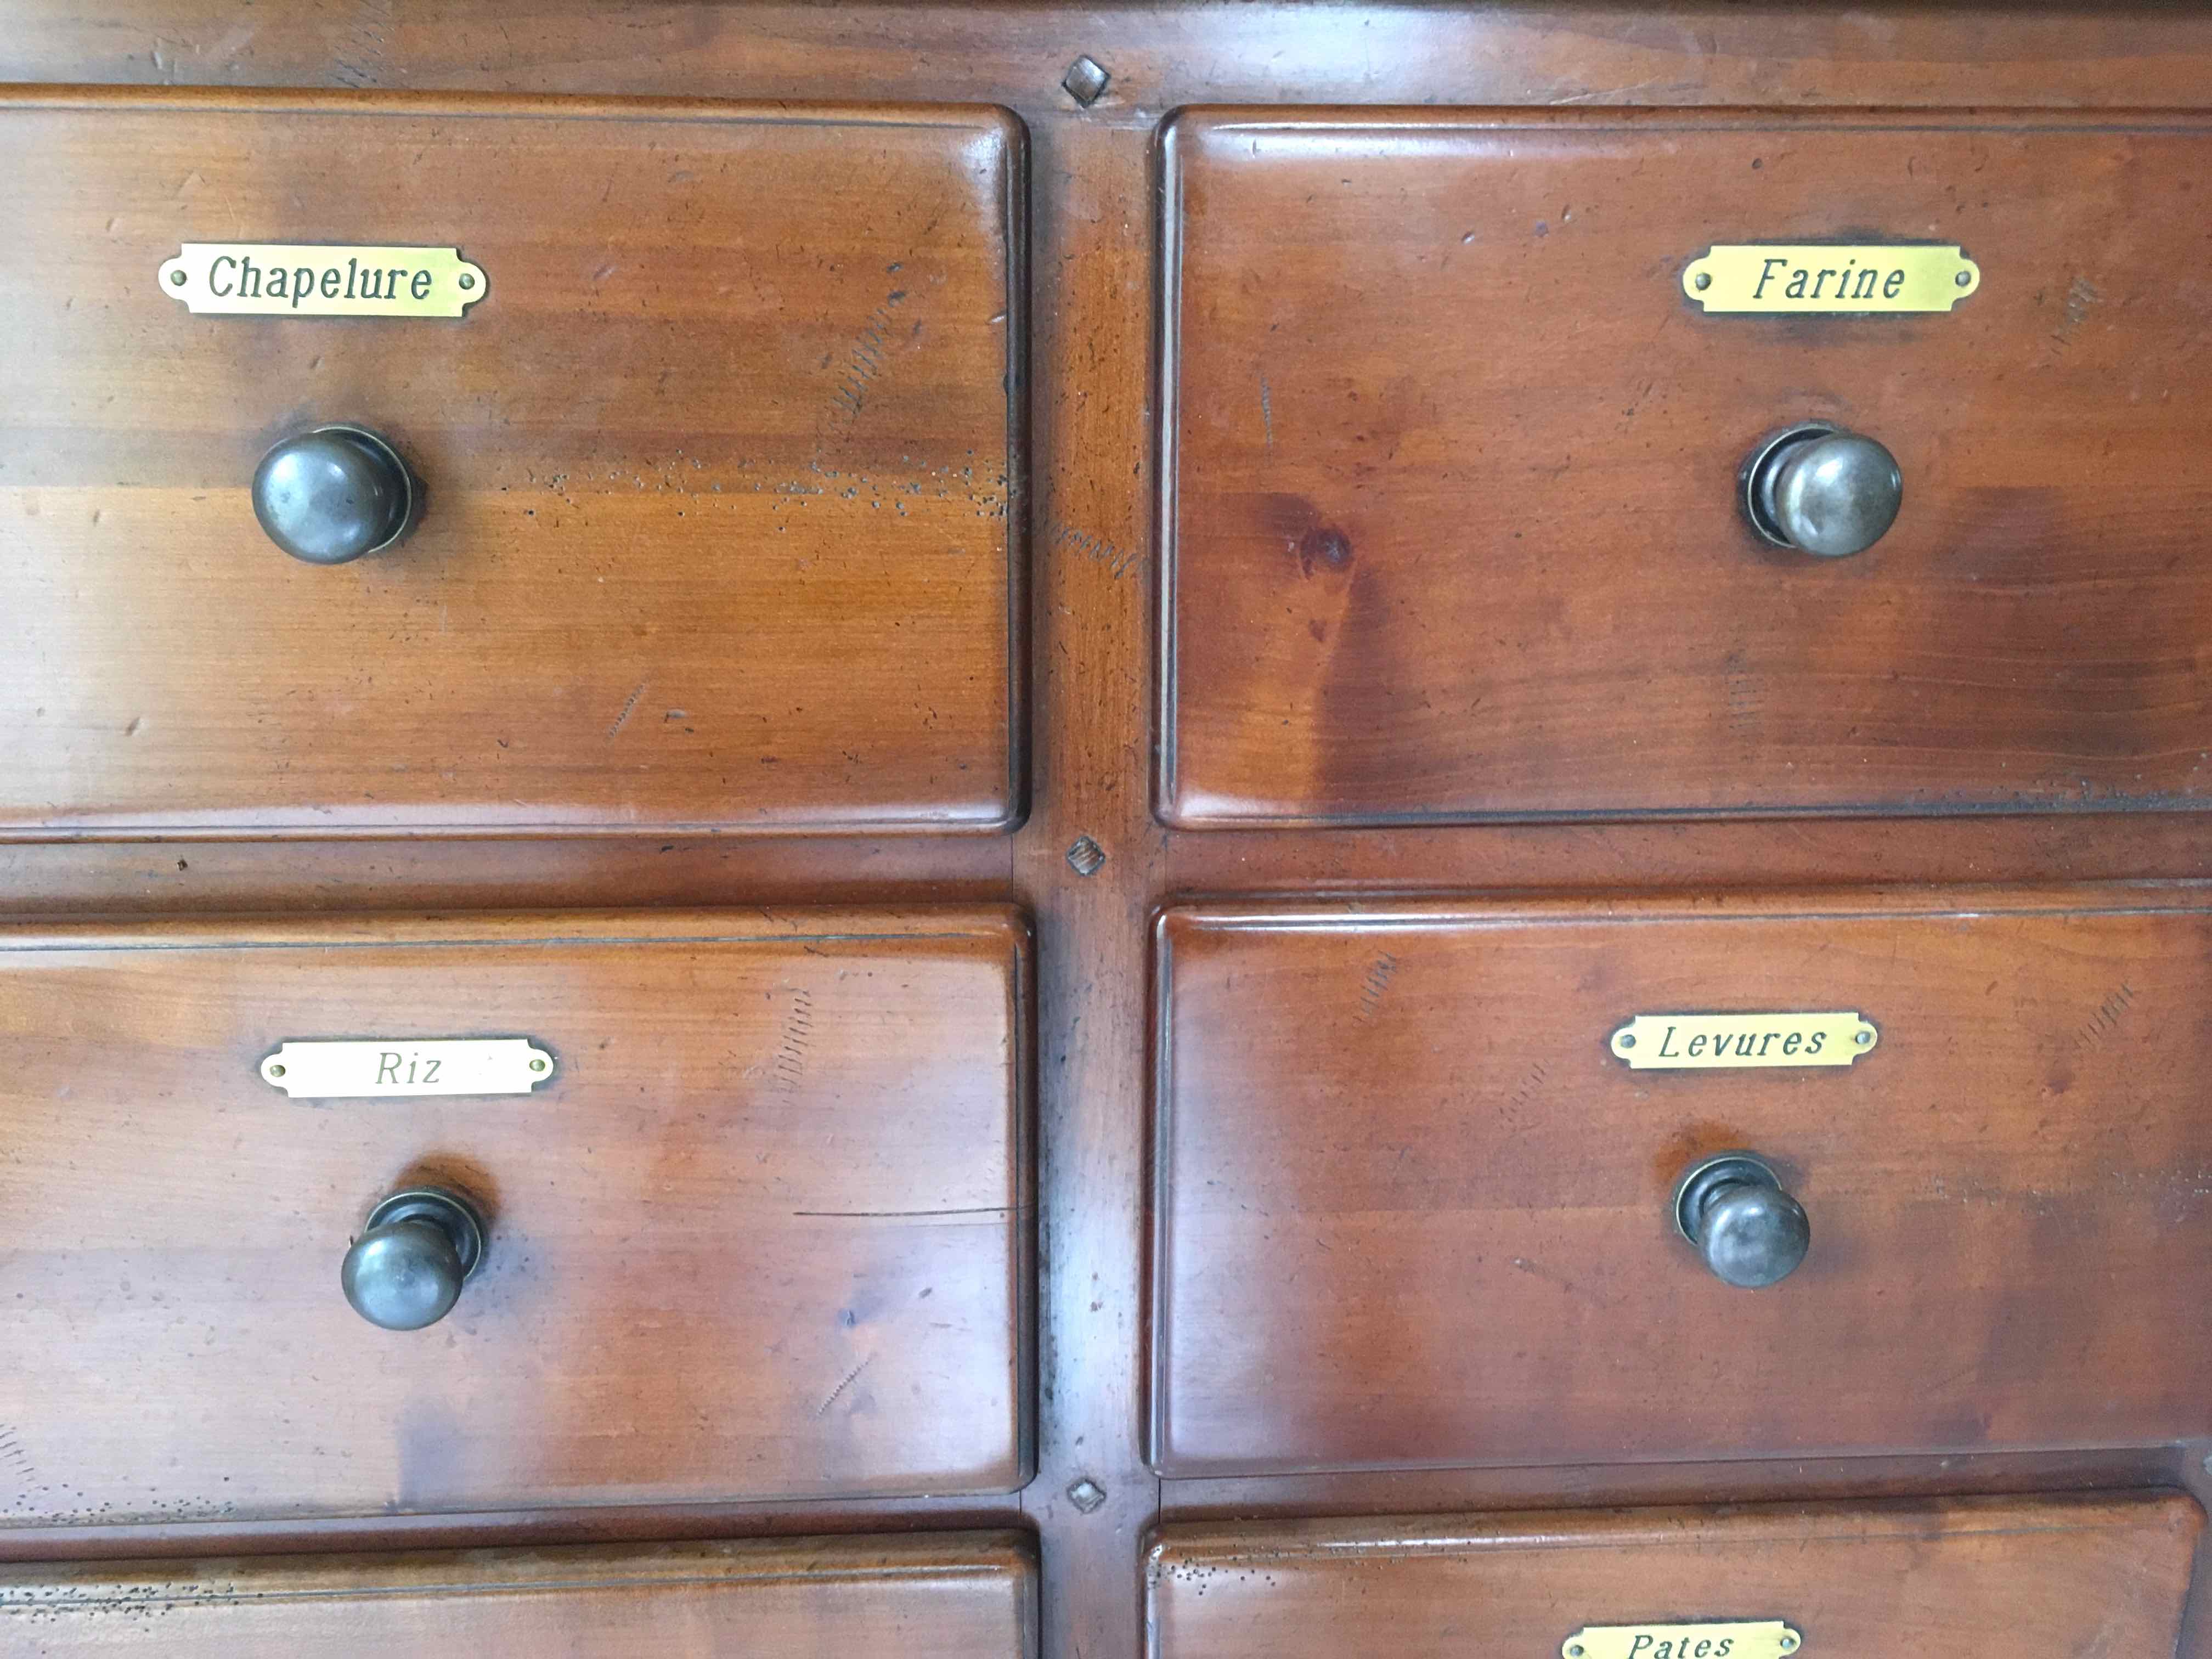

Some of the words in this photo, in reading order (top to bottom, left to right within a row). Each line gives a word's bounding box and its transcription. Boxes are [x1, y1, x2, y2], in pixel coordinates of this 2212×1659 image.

[209, 256, 432, 308] Chapelure
[1753, 258, 1905, 299] Farine
[1658, 1026, 1827, 1057] Levures
[375, 1052, 442, 1085] Riz
[1628, 1634, 1734, 1659] Pates
